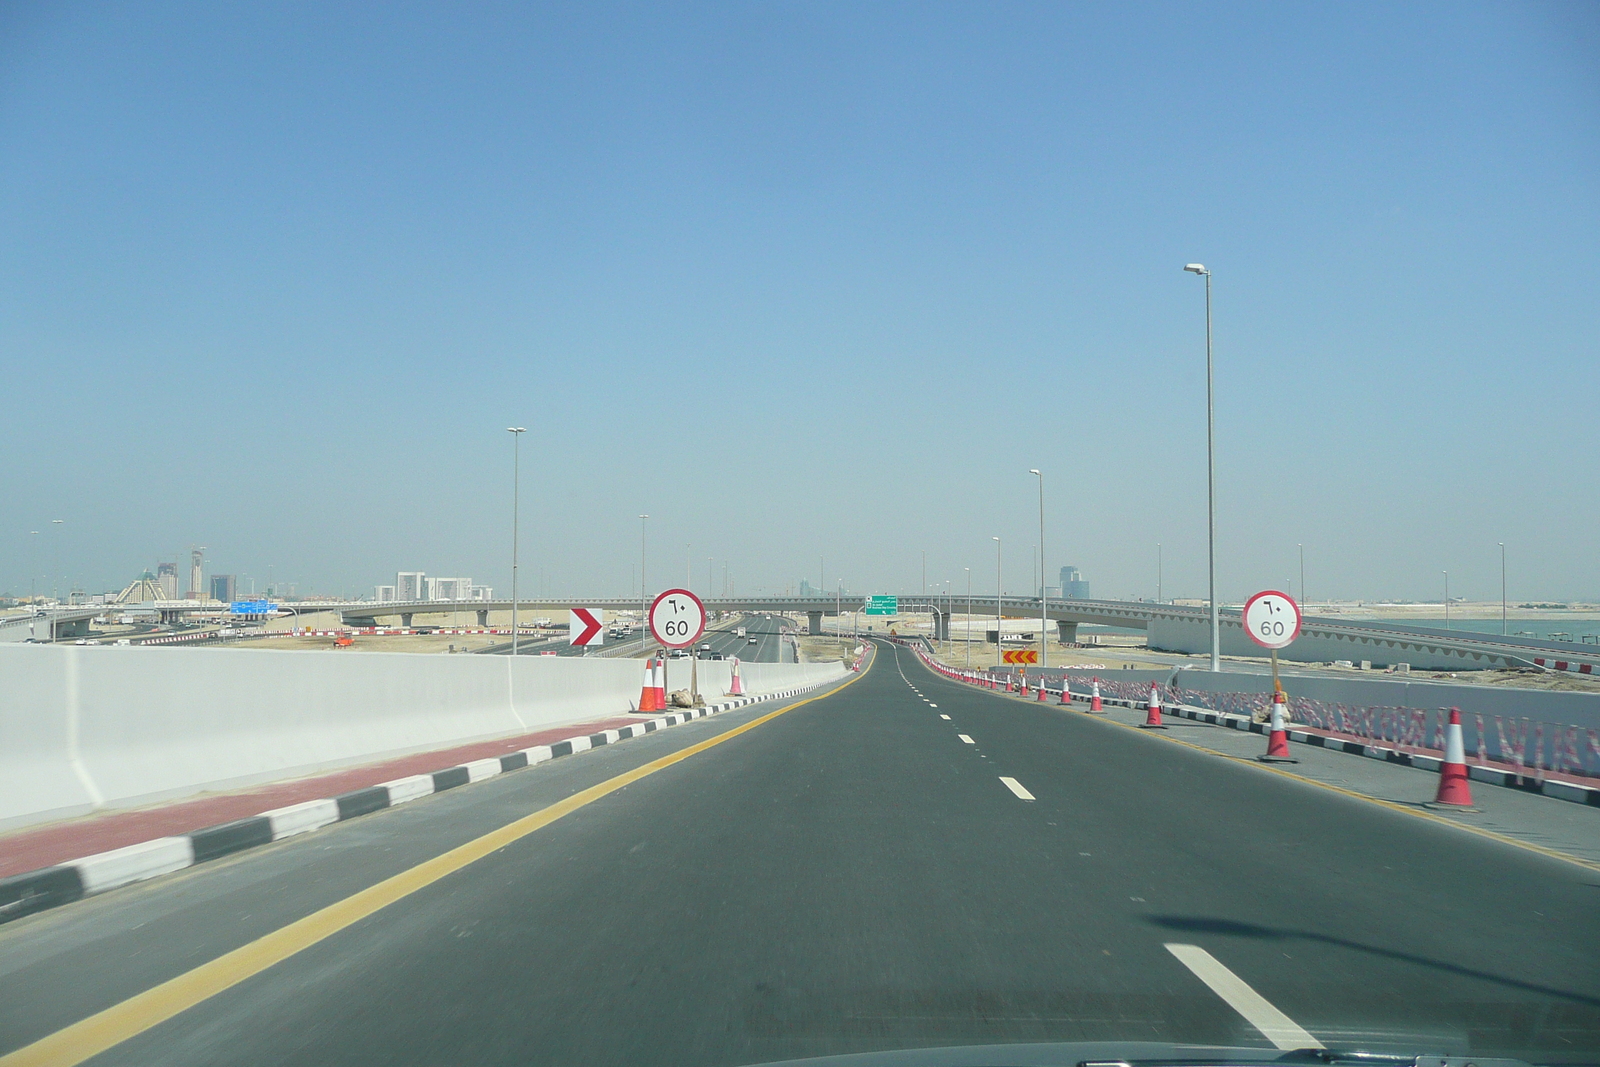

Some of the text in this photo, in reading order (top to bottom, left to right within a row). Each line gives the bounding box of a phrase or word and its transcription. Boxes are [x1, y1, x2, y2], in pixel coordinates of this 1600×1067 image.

[668, 600, 686, 615] ٦٠
[1263, 601, 1281, 615] ٦٠
[665, 620, 688, 636] 60
[1260, 621, 1284, 636] 60
